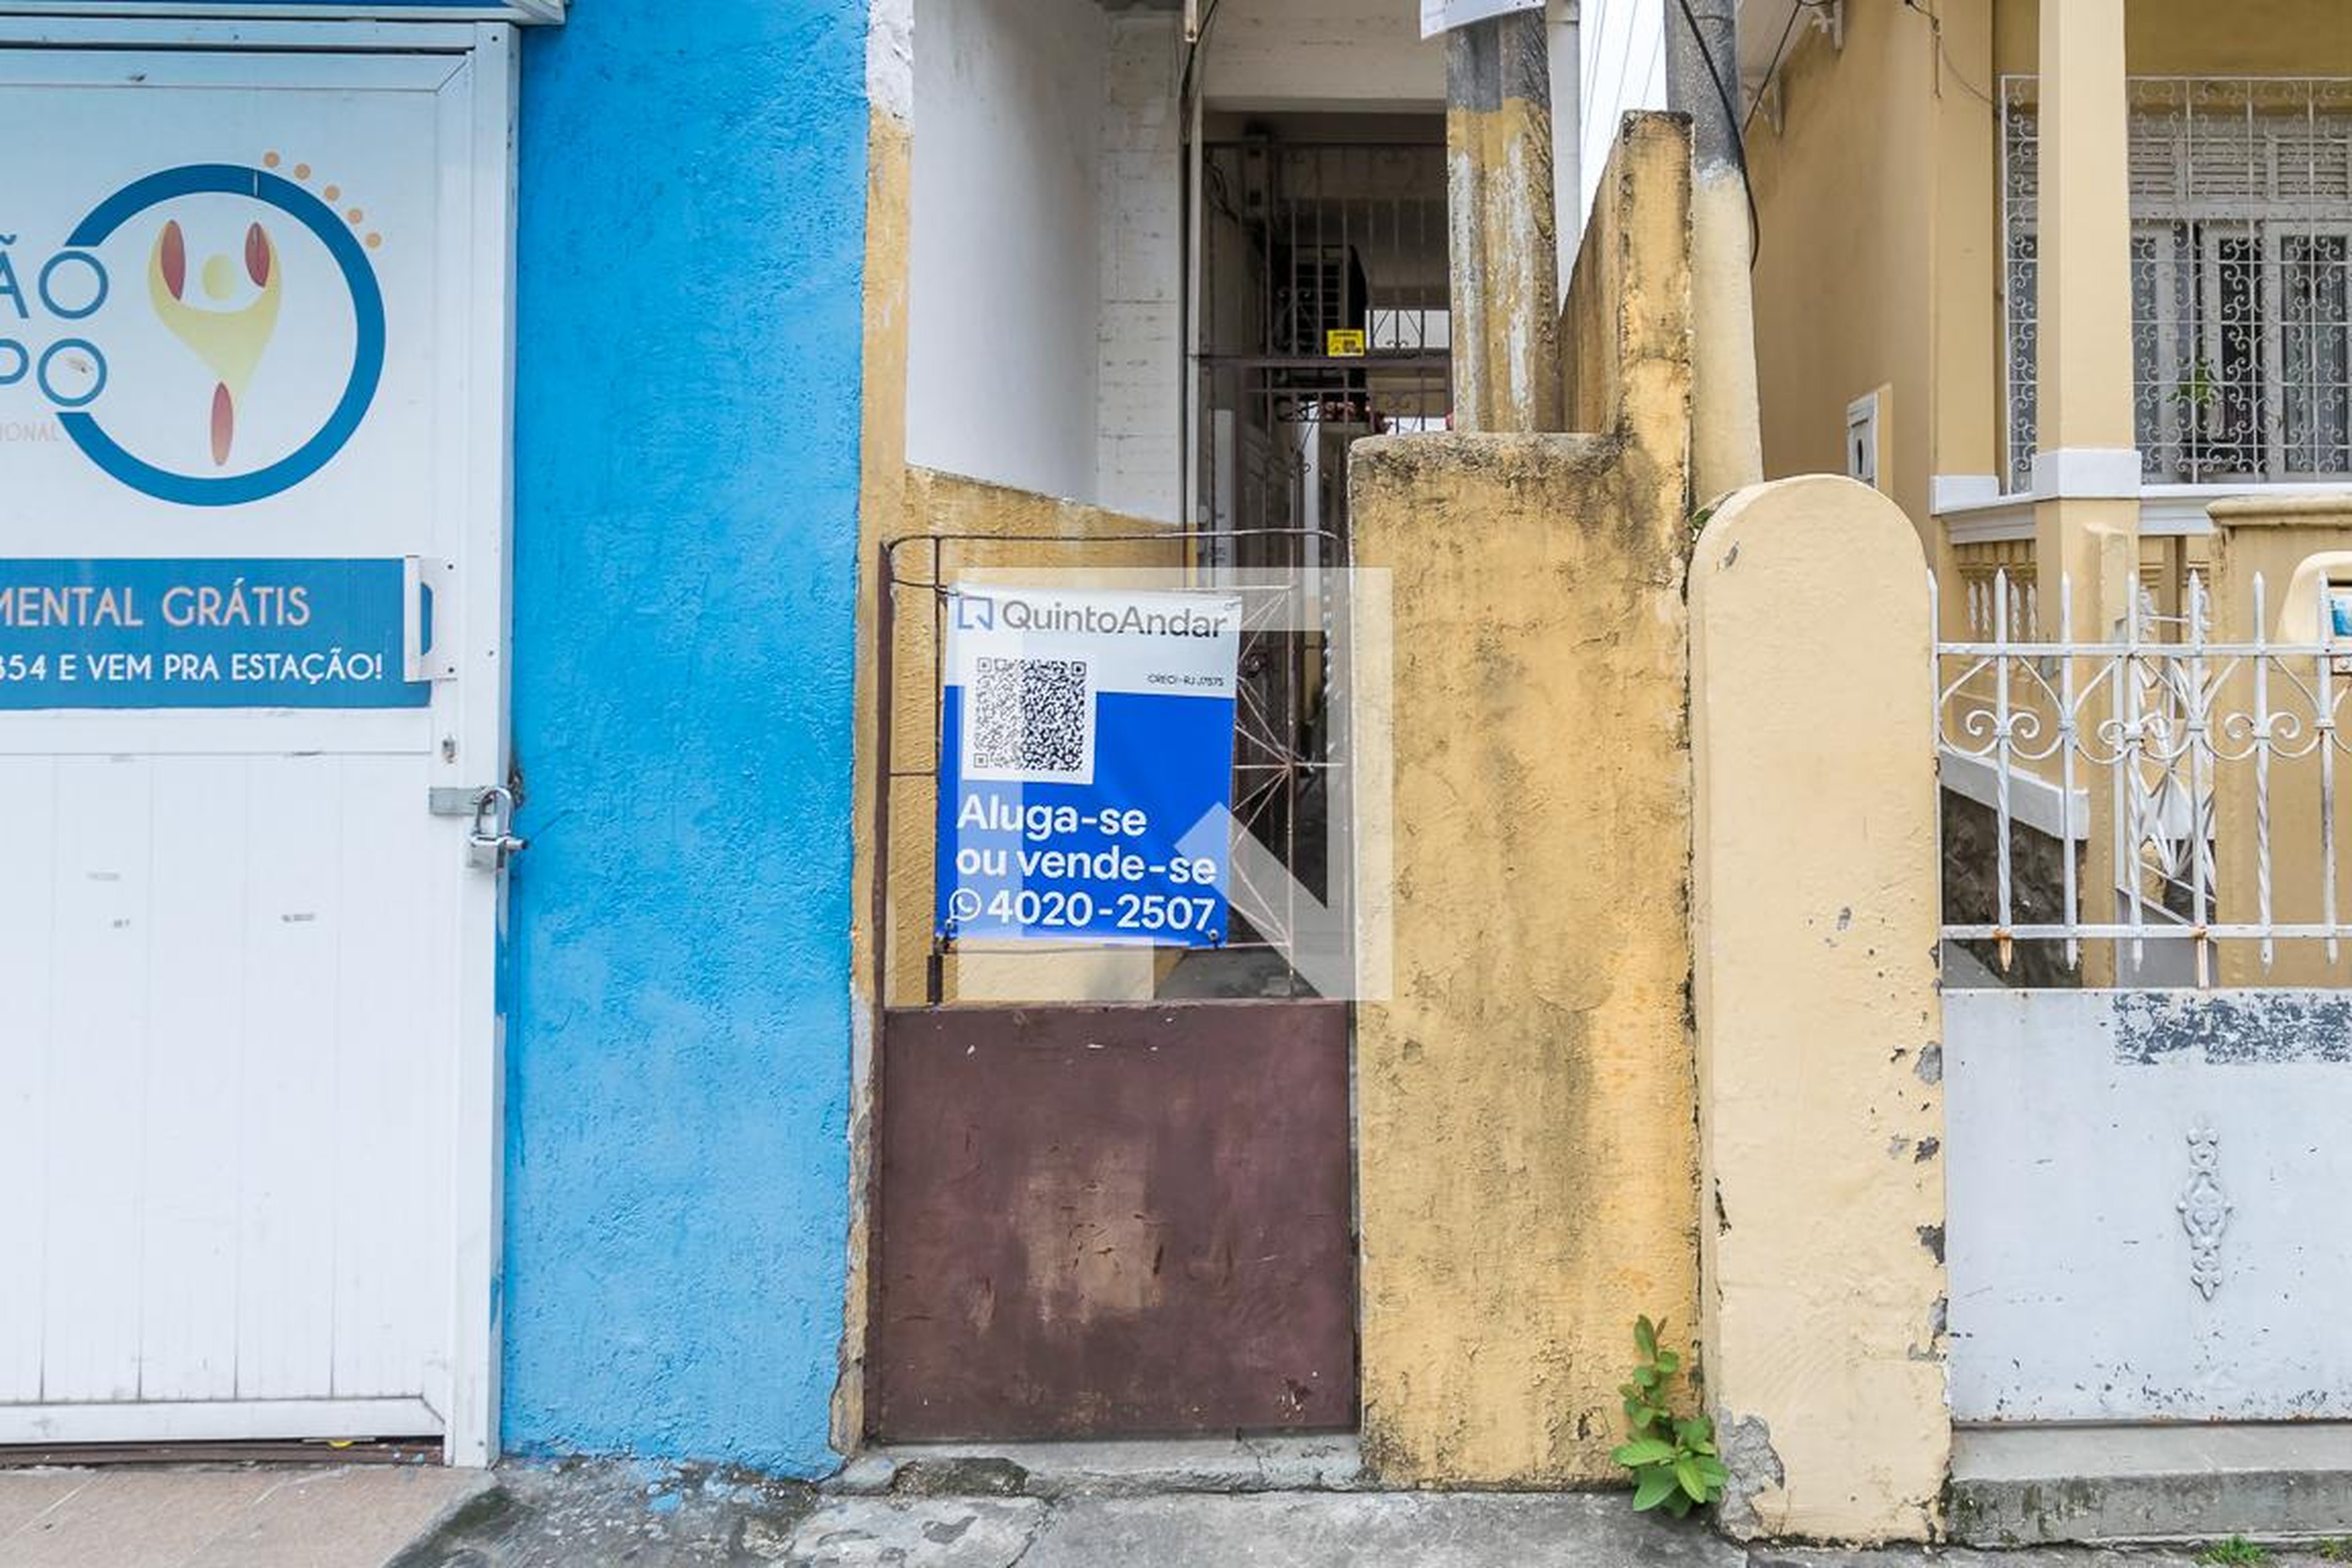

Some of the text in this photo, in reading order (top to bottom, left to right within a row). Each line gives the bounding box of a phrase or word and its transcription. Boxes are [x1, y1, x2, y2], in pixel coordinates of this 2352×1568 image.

[162, 578, 310, 626] GRÁTIS
[1002, 600, 1226, 638] QuintoAndar
[59, 655, 76, 680] E
[87, 654, 151, 680] VEM
[164, 654, 220, 680] PRA
[232, 647, 382, 684] ESTAÇÃO!
[957, 795, 1147, 840] Aluga-se
[956, 846, 1218, 886] ou vende-se
[988, 890, 1216, 931] 4020-2507
